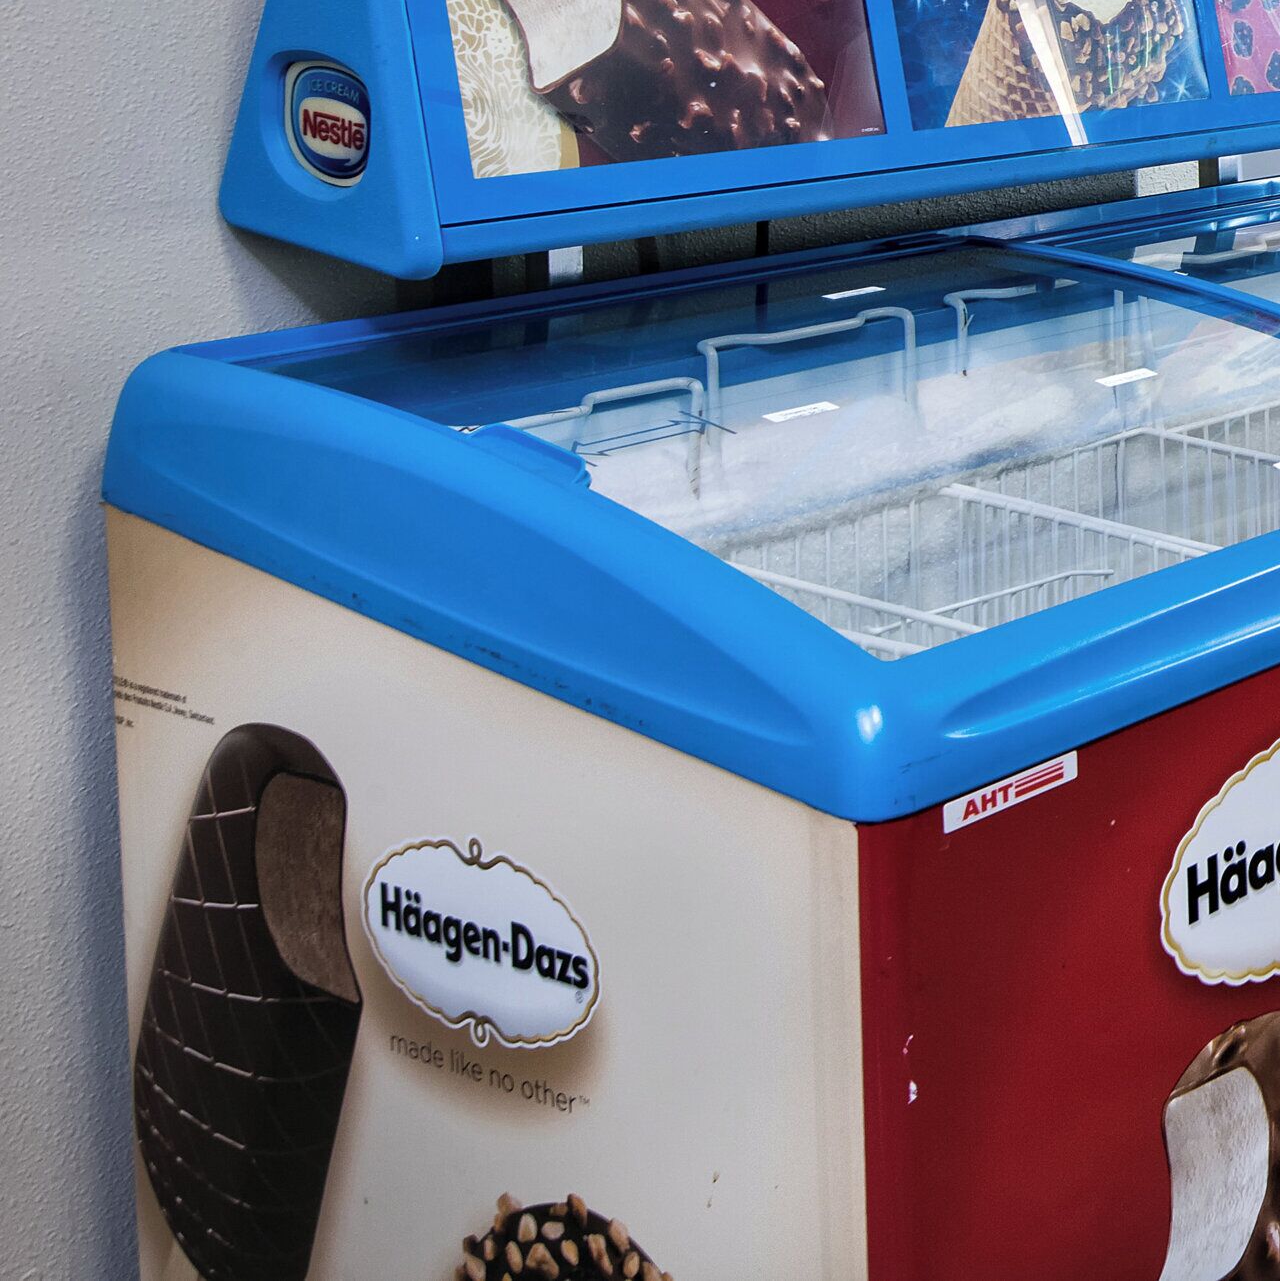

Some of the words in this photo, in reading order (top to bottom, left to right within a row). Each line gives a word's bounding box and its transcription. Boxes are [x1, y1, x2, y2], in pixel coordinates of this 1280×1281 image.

[308, 79, 323, 92] ICE
[324, 81, 360, 106] CREAM
[302, 108, 365, 151] Nestlé
[961, 782, 1015, 822] AHT
[379, 881, 590, 990] Häagen-Dazs
[389, 1032, 444, 1069] made
[448, 1046, 485, 1083] like
[487, 1064, 515, 1094] no
